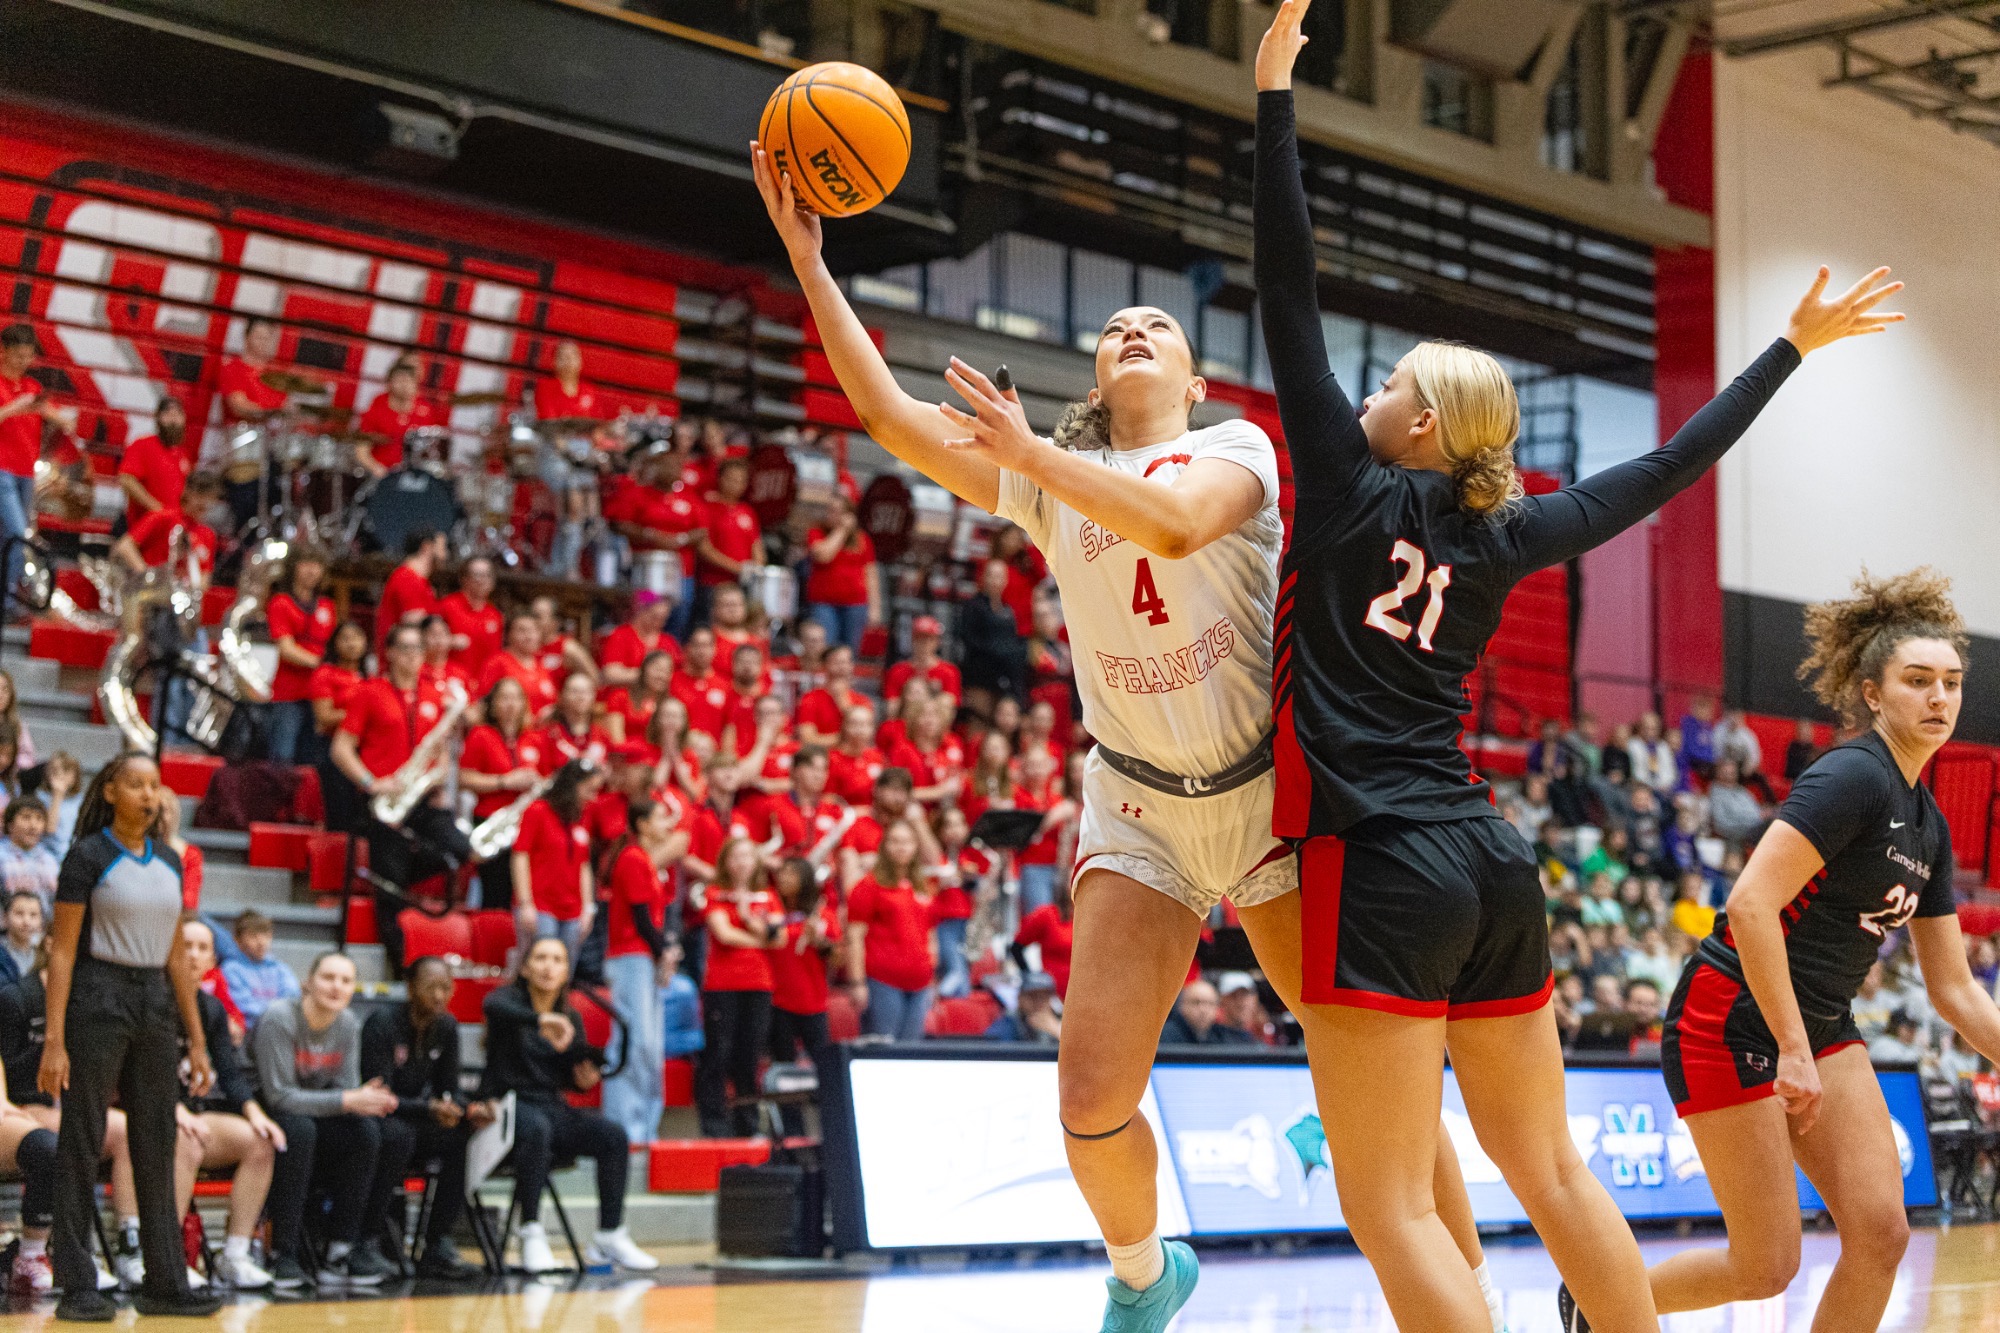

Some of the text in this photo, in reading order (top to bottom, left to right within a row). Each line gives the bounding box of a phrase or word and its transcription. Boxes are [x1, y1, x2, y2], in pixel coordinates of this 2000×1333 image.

[774, 148, 815, 212] ilsn
[810, 148, 867, 208] NCAA
[1079, 519, 1128, 563] SA
[1131, 557, 1170, 627] 4
[1363, 537, 1452, 653] 21
[1096, 616, 1235, 694] FRANCIS
[1886, 845, 1917, 874] Carnegie
[1859, 884, 1919, 936] 22
